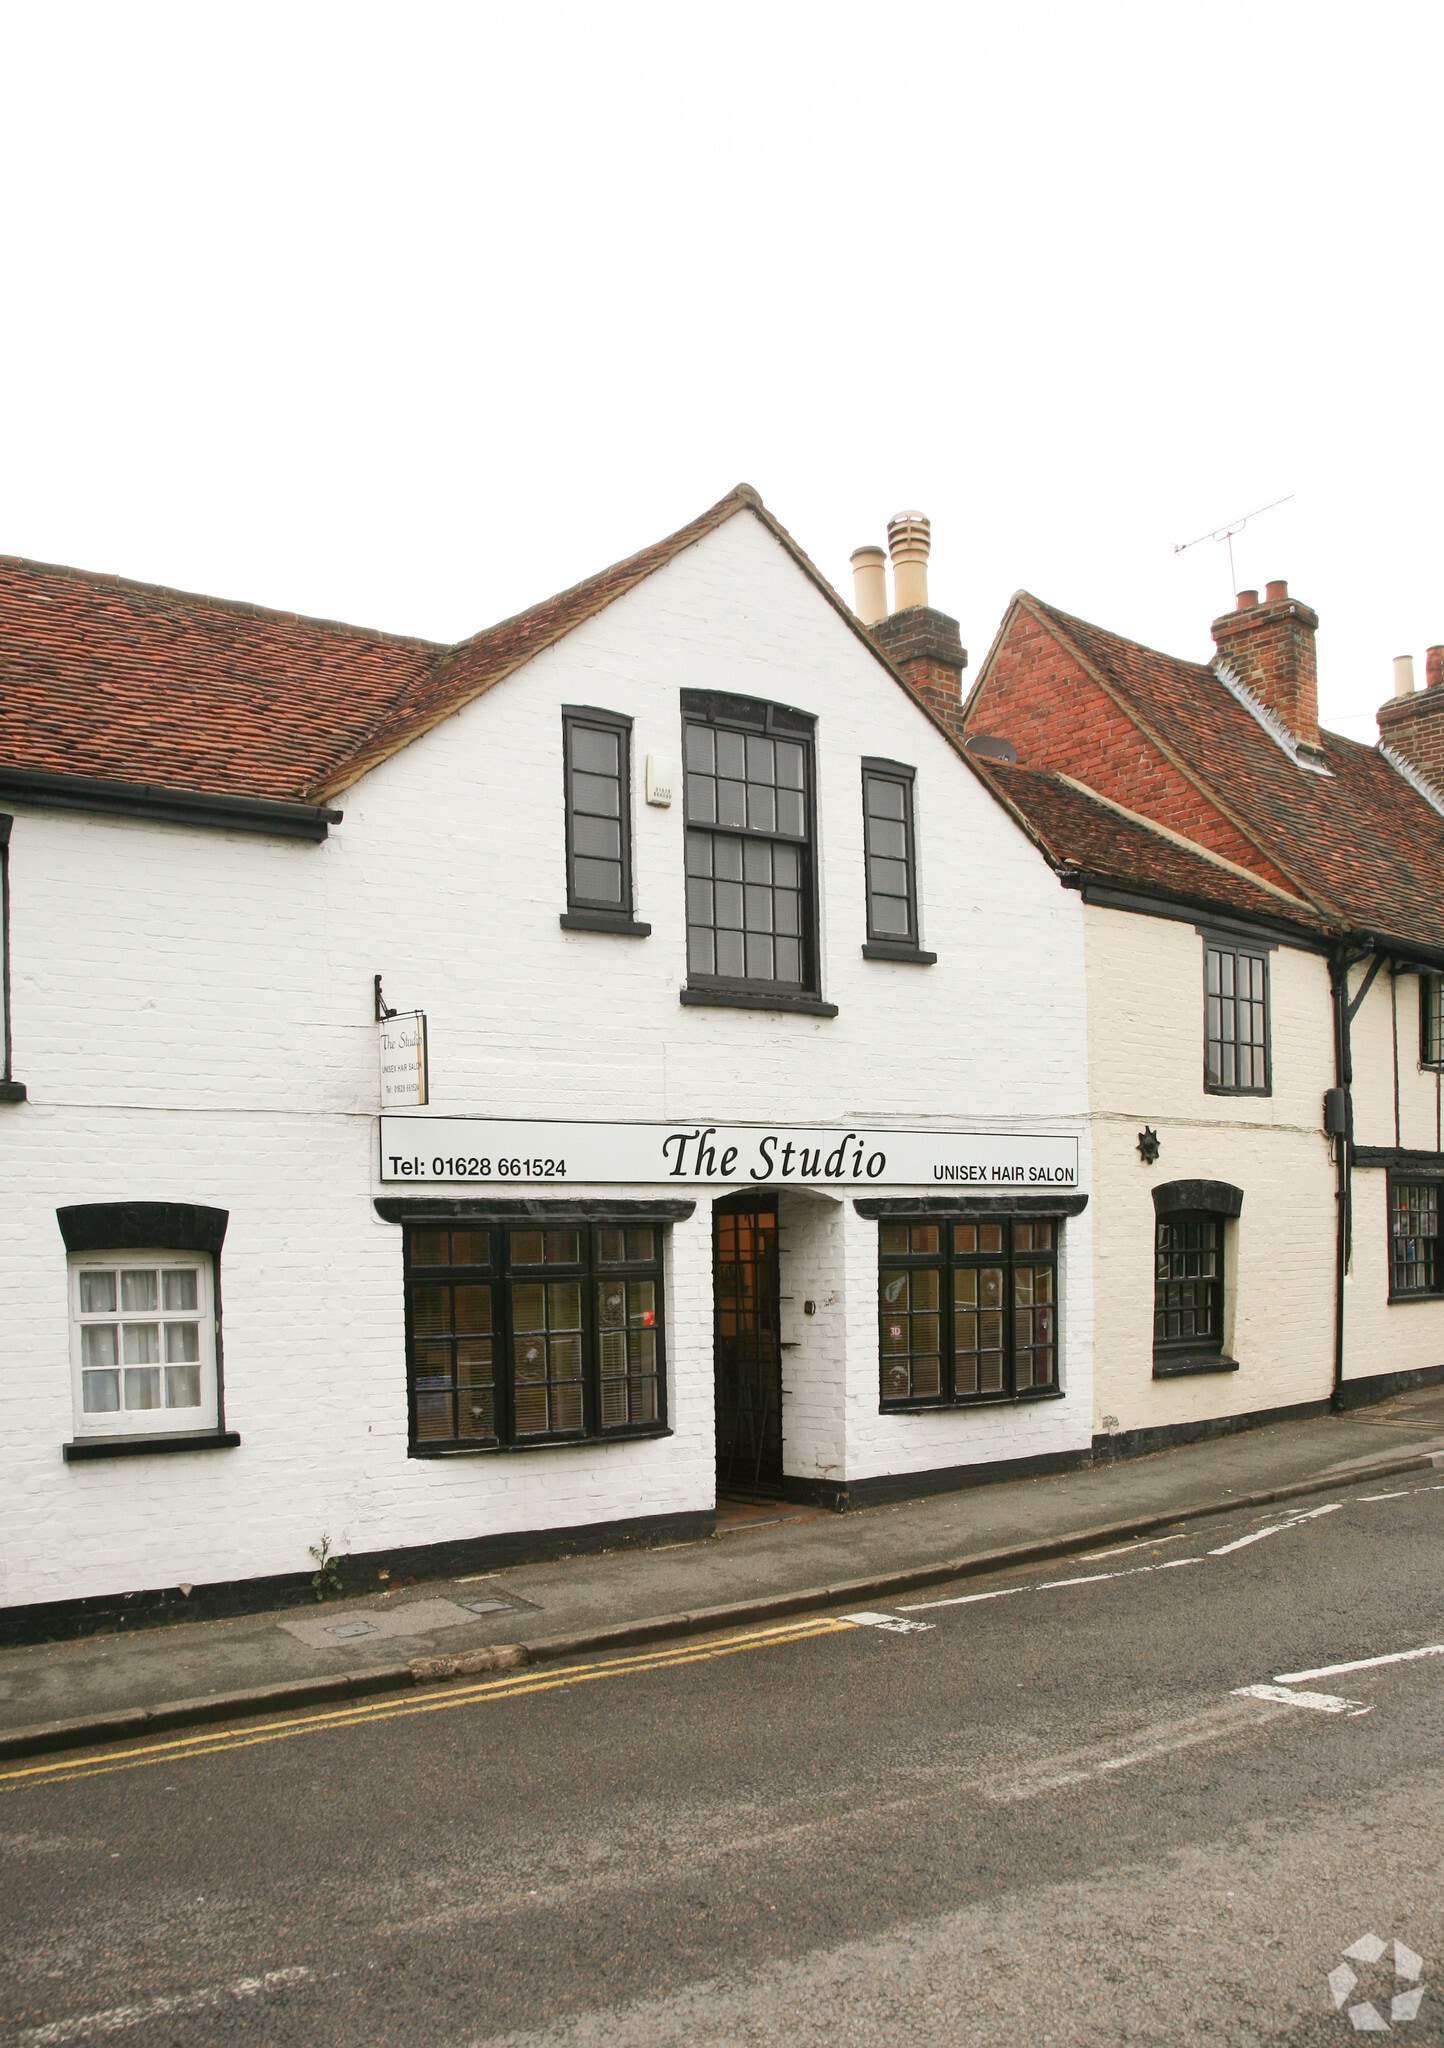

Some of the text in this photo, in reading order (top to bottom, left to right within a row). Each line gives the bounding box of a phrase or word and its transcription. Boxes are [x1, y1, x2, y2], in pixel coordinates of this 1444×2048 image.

[380, 1031, 422, 1050] The Studio
[382, 1064, 397, 1074] UNISEX
[397, 1063, 408, 1072] HAIR
[663, 1127, 887, 1181] The Studio
[389, 1157, 567, 1177] Tel: 01628 661524
[933, 1165, 1074, 1182] UNISEX HAIR SALON
